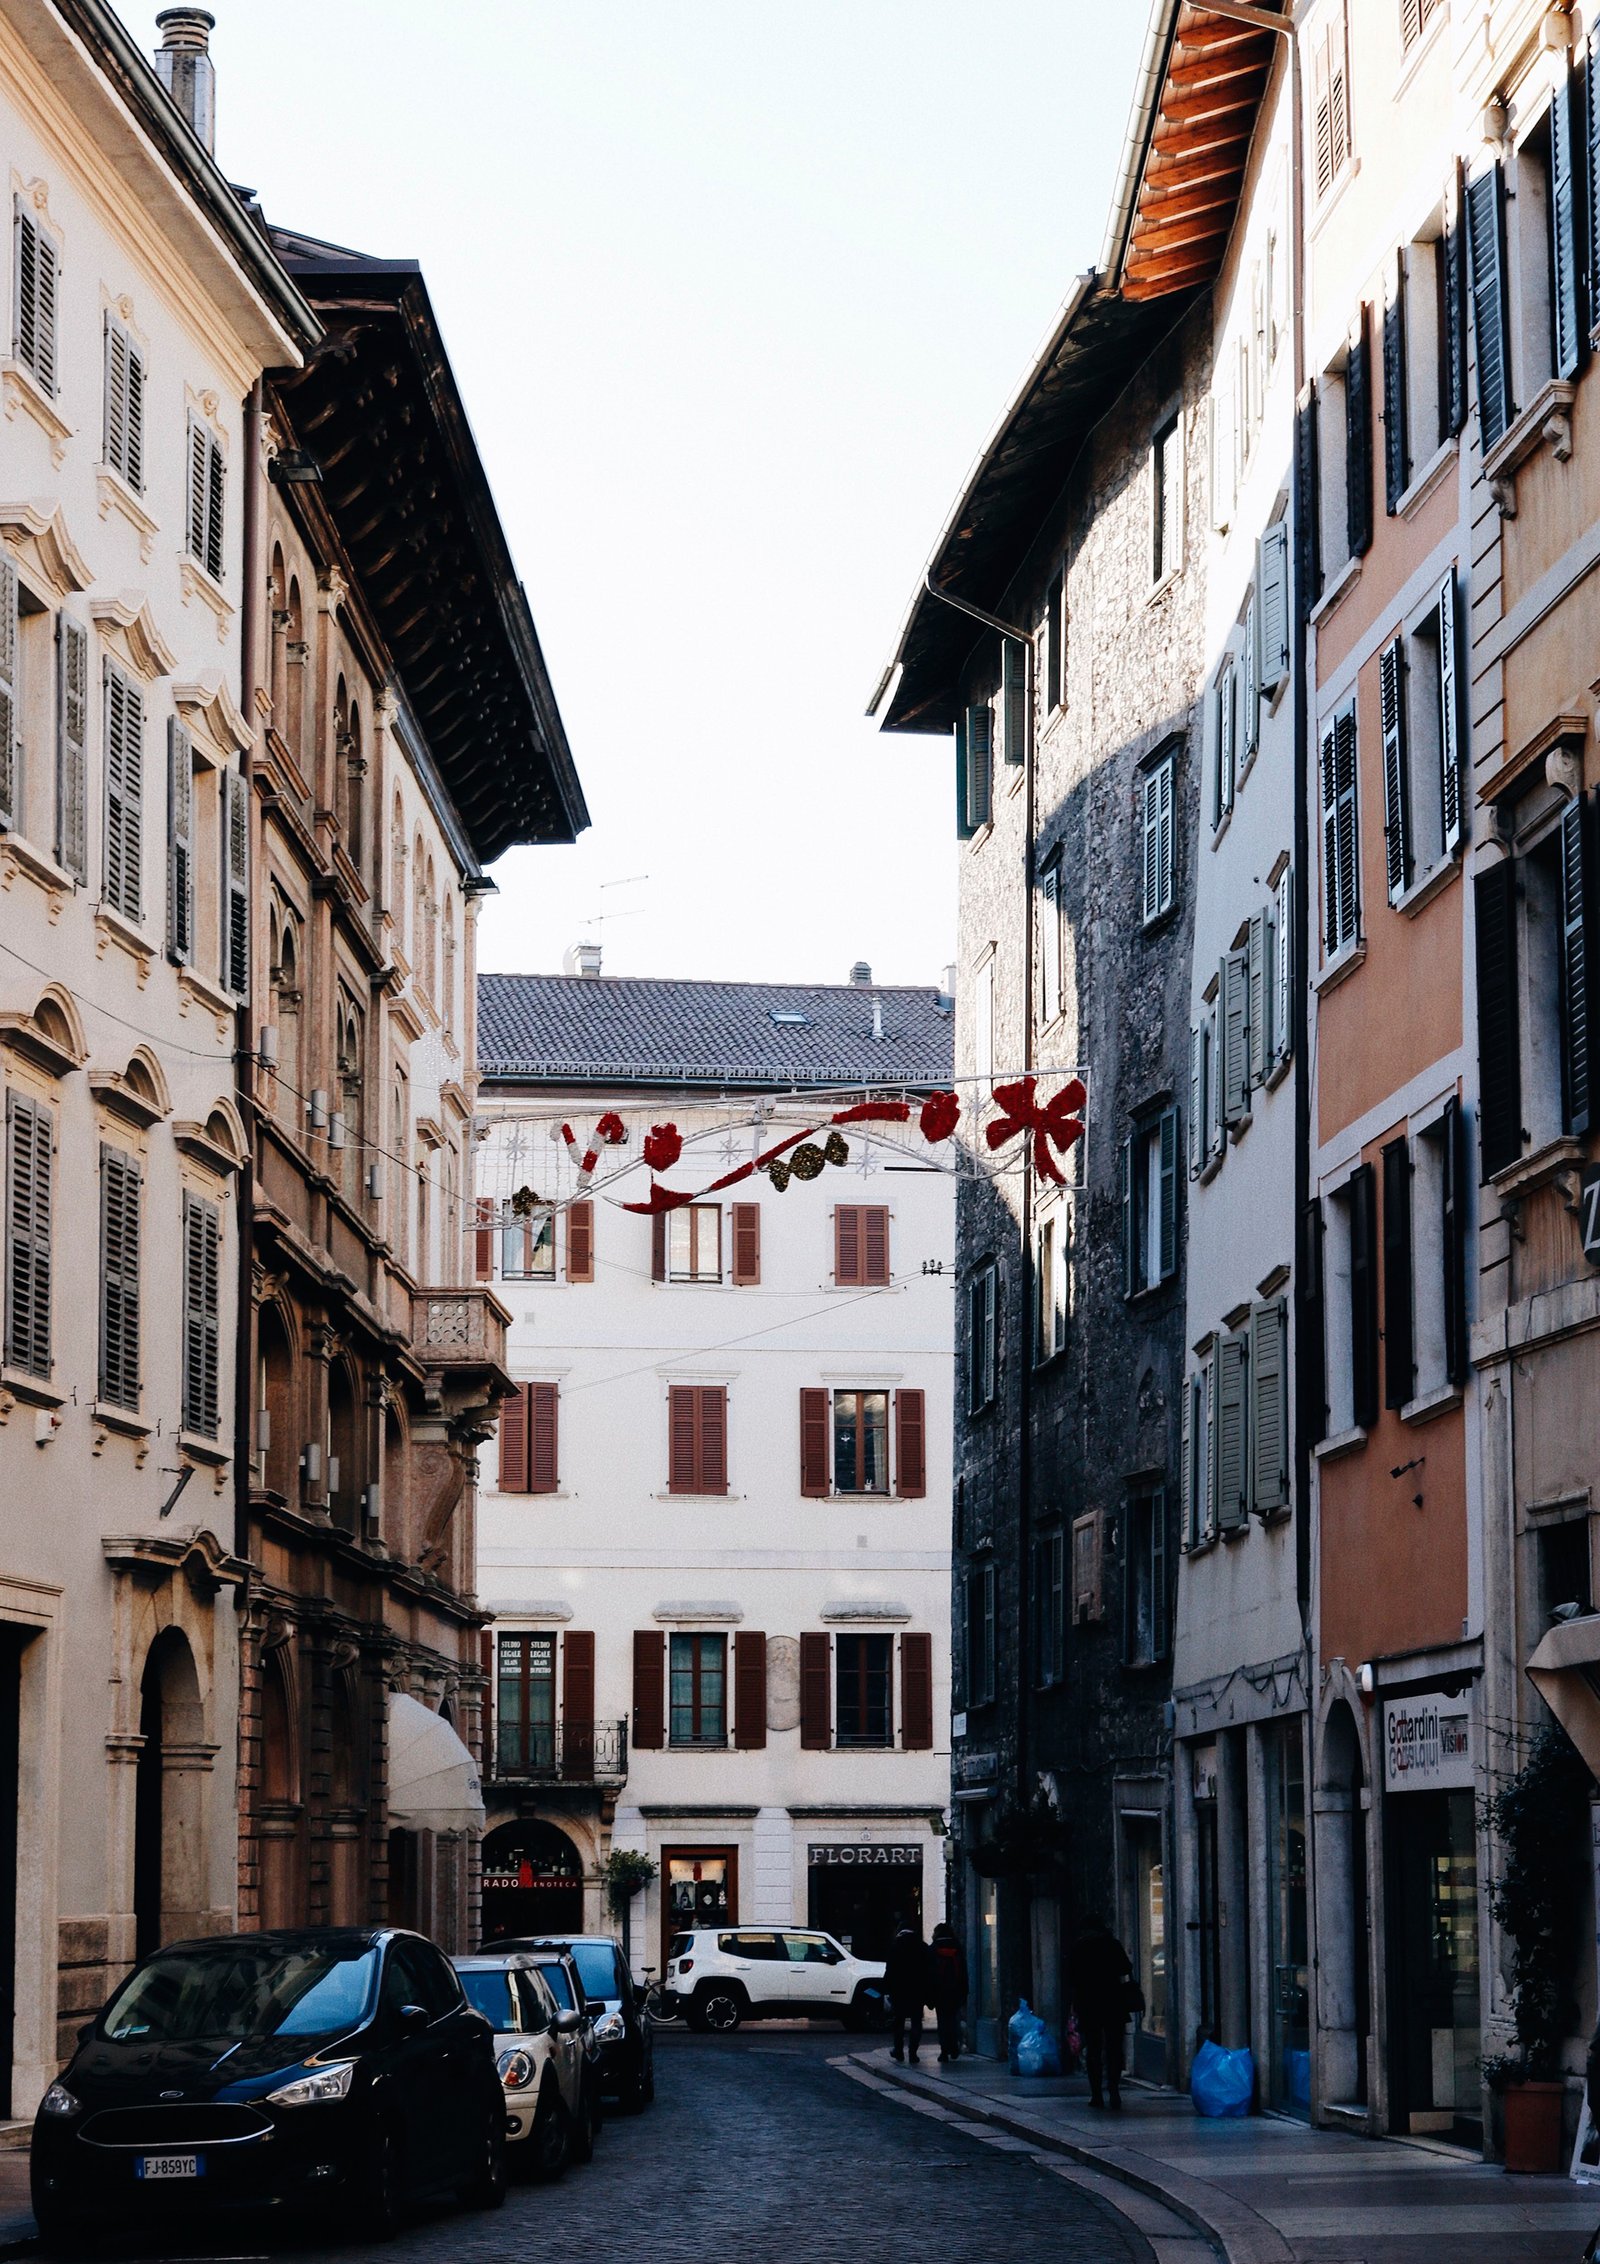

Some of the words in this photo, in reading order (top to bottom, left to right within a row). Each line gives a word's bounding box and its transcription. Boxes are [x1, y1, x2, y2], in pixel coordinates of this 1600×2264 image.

[501, 1640, 521, 1648] STUDIO
[530, 1641, 551, 1649] STUDIO
[500, 1650, 521, 1658] LEGALE
[530, 1650, 551, 1658] LEGALE
[1388, 1706, 1438, 1744] Gottardini
[1440, 1728, 1468, 1754] Vision
[811, 1848, 920, 1864] FLORART
[483, 1879, 519, 1888] RADO
